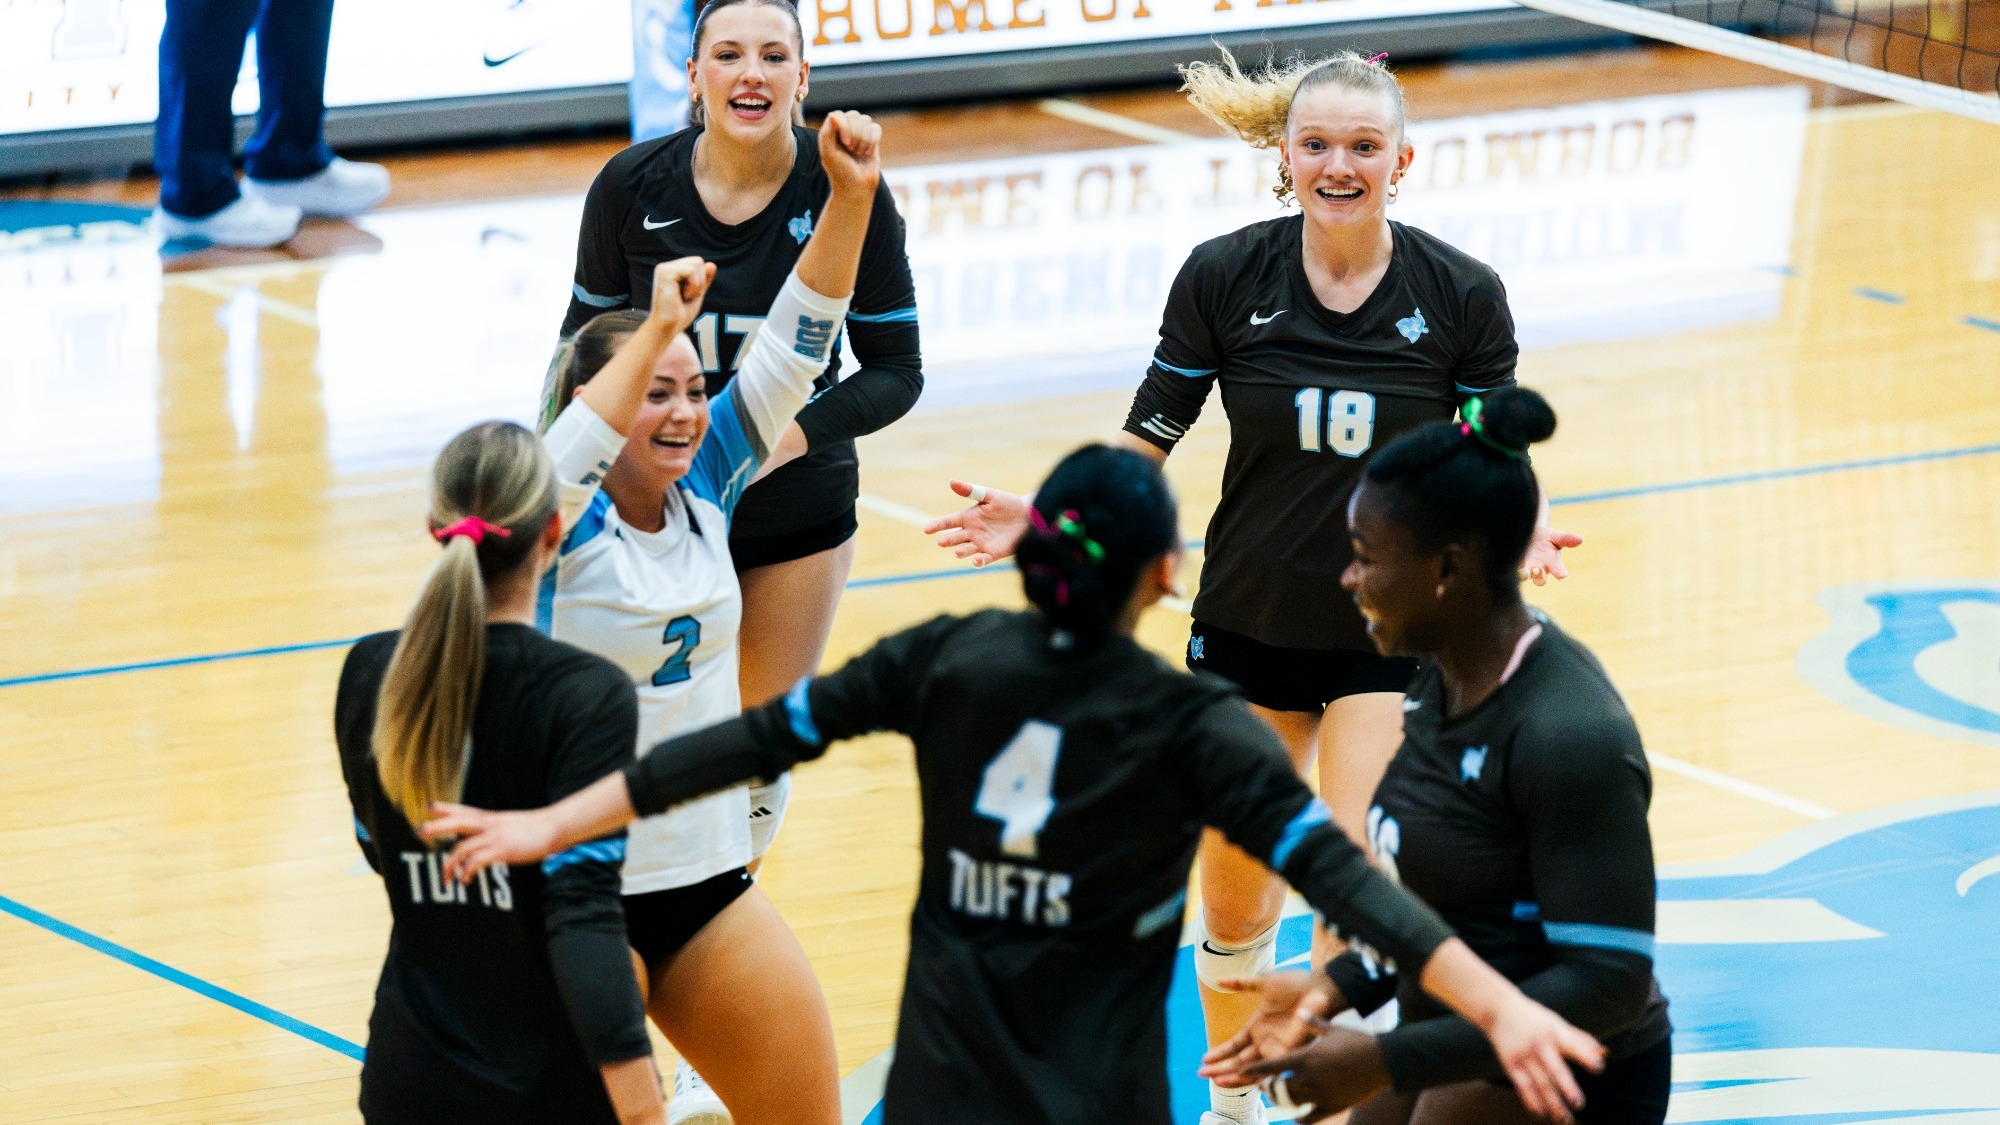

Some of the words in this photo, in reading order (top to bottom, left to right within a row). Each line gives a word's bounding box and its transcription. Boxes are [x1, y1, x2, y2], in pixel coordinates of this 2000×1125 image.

[693, 312, 767, 373] 17
[1294, 386, 1376, 459] 18
[651, 614, 702, 687] 2
[971, 717, 1065, 858] 4
[947, 847, 1073, 927] TUFTS
